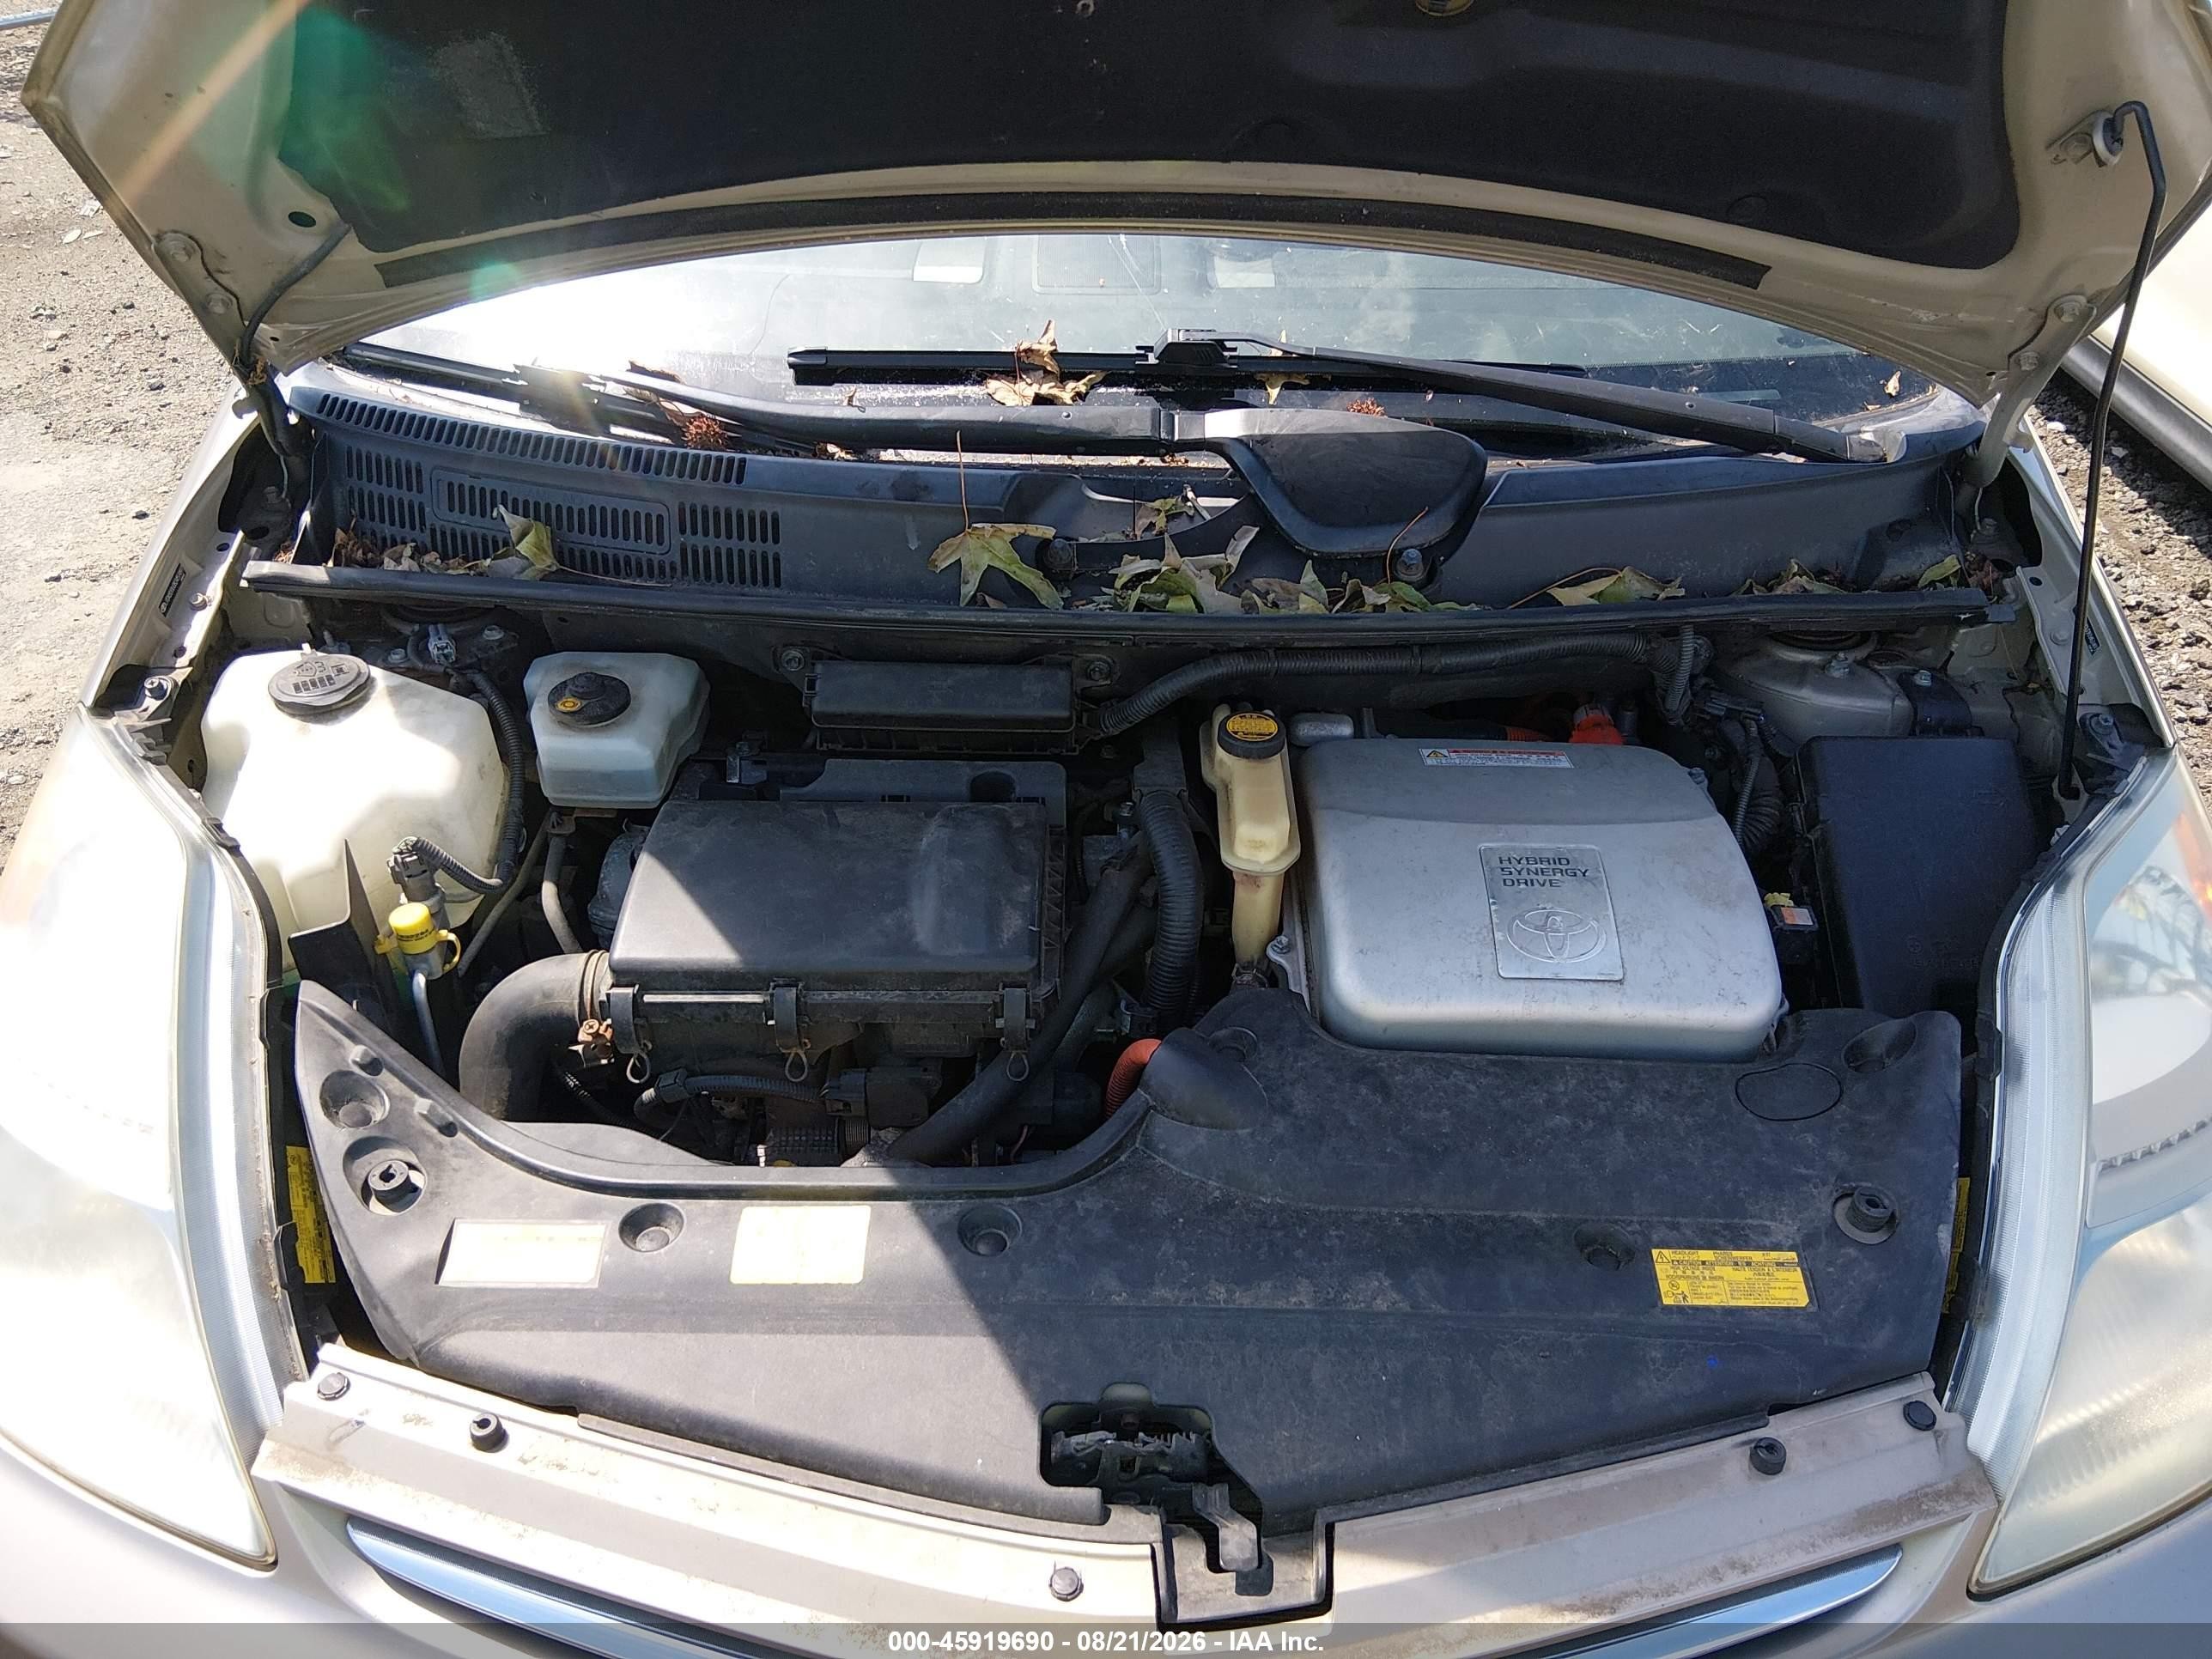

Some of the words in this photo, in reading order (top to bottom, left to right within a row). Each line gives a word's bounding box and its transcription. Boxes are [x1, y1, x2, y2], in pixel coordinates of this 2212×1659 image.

[1498, 856, 1571, 866] HYBRID
[1501, 867, 1589, 878] SYNERGY
[1503, 878, 1561, 887] DRIVE
